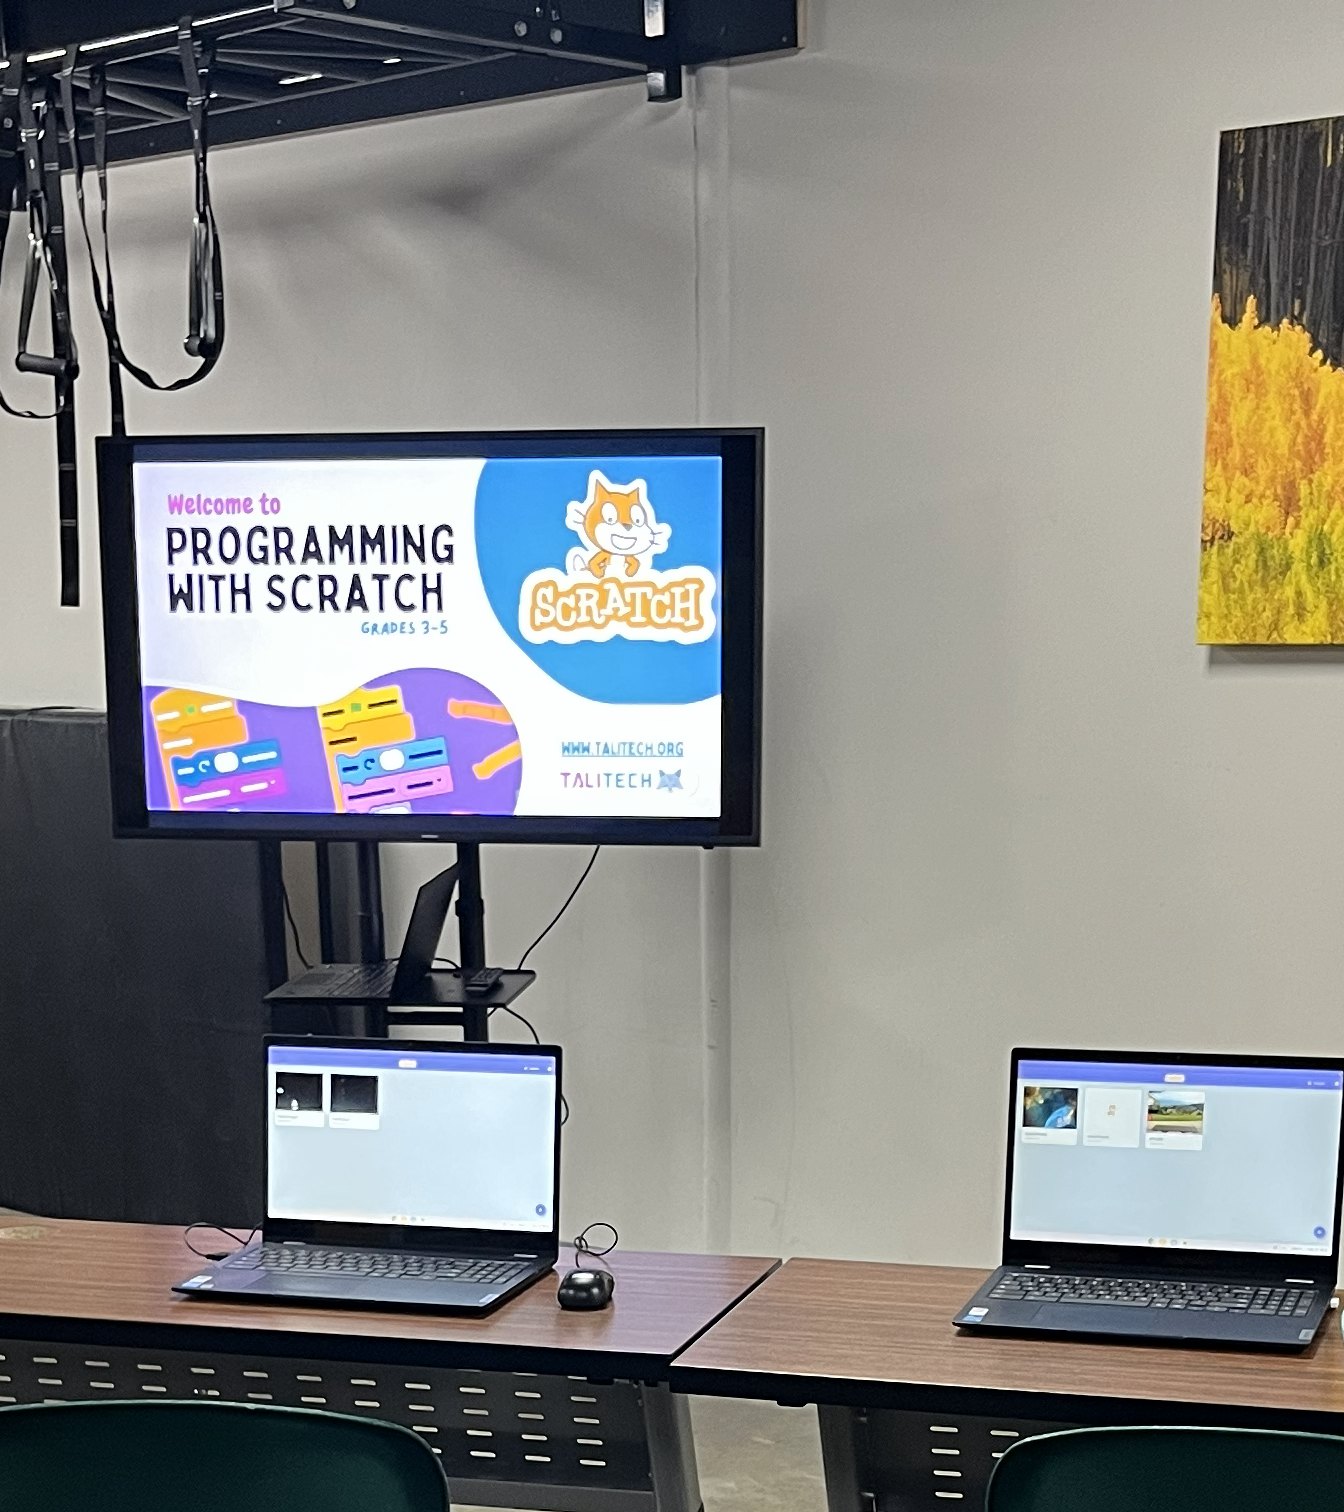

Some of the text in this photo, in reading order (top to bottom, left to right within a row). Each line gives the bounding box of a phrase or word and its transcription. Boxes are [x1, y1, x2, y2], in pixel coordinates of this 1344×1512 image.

[167, 493, 281, 515] Welcome to
[166, 524, 455, 566] PROGRAMMING
[168, 572, 443, 613] WITH SCRATCH
[534, 582, 700, 628] SCRATCH
[361, 620, 448, 635] GRADES 3-5
[561, 741, 684, 757] WWW.TALITECH.ORG
[560, 772, 652, 788] TALITECH
